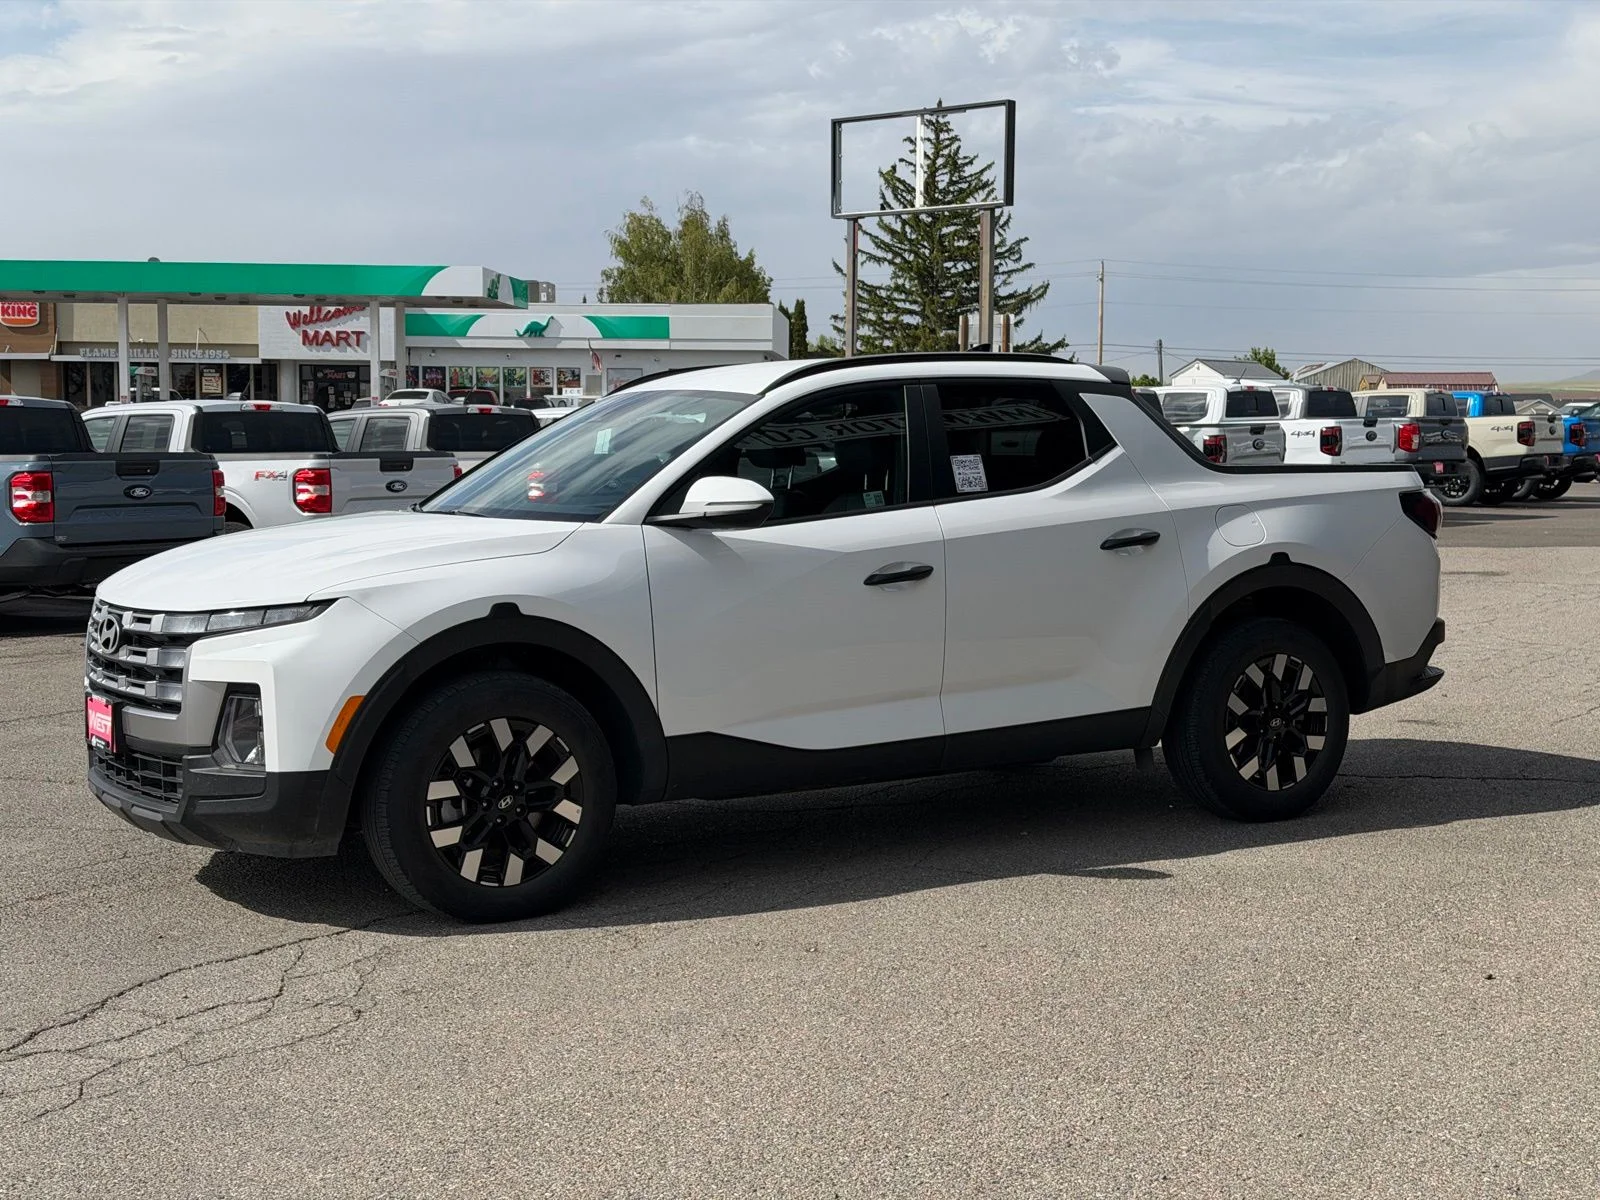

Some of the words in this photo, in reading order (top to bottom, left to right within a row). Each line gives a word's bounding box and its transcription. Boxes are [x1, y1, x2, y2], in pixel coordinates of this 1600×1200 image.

[1, 305, 37, 317] KING
[302, 329, 365, 347] MART
[171, 349, 203, 359] SINCE
[254, 471, 288, 481] FX4
